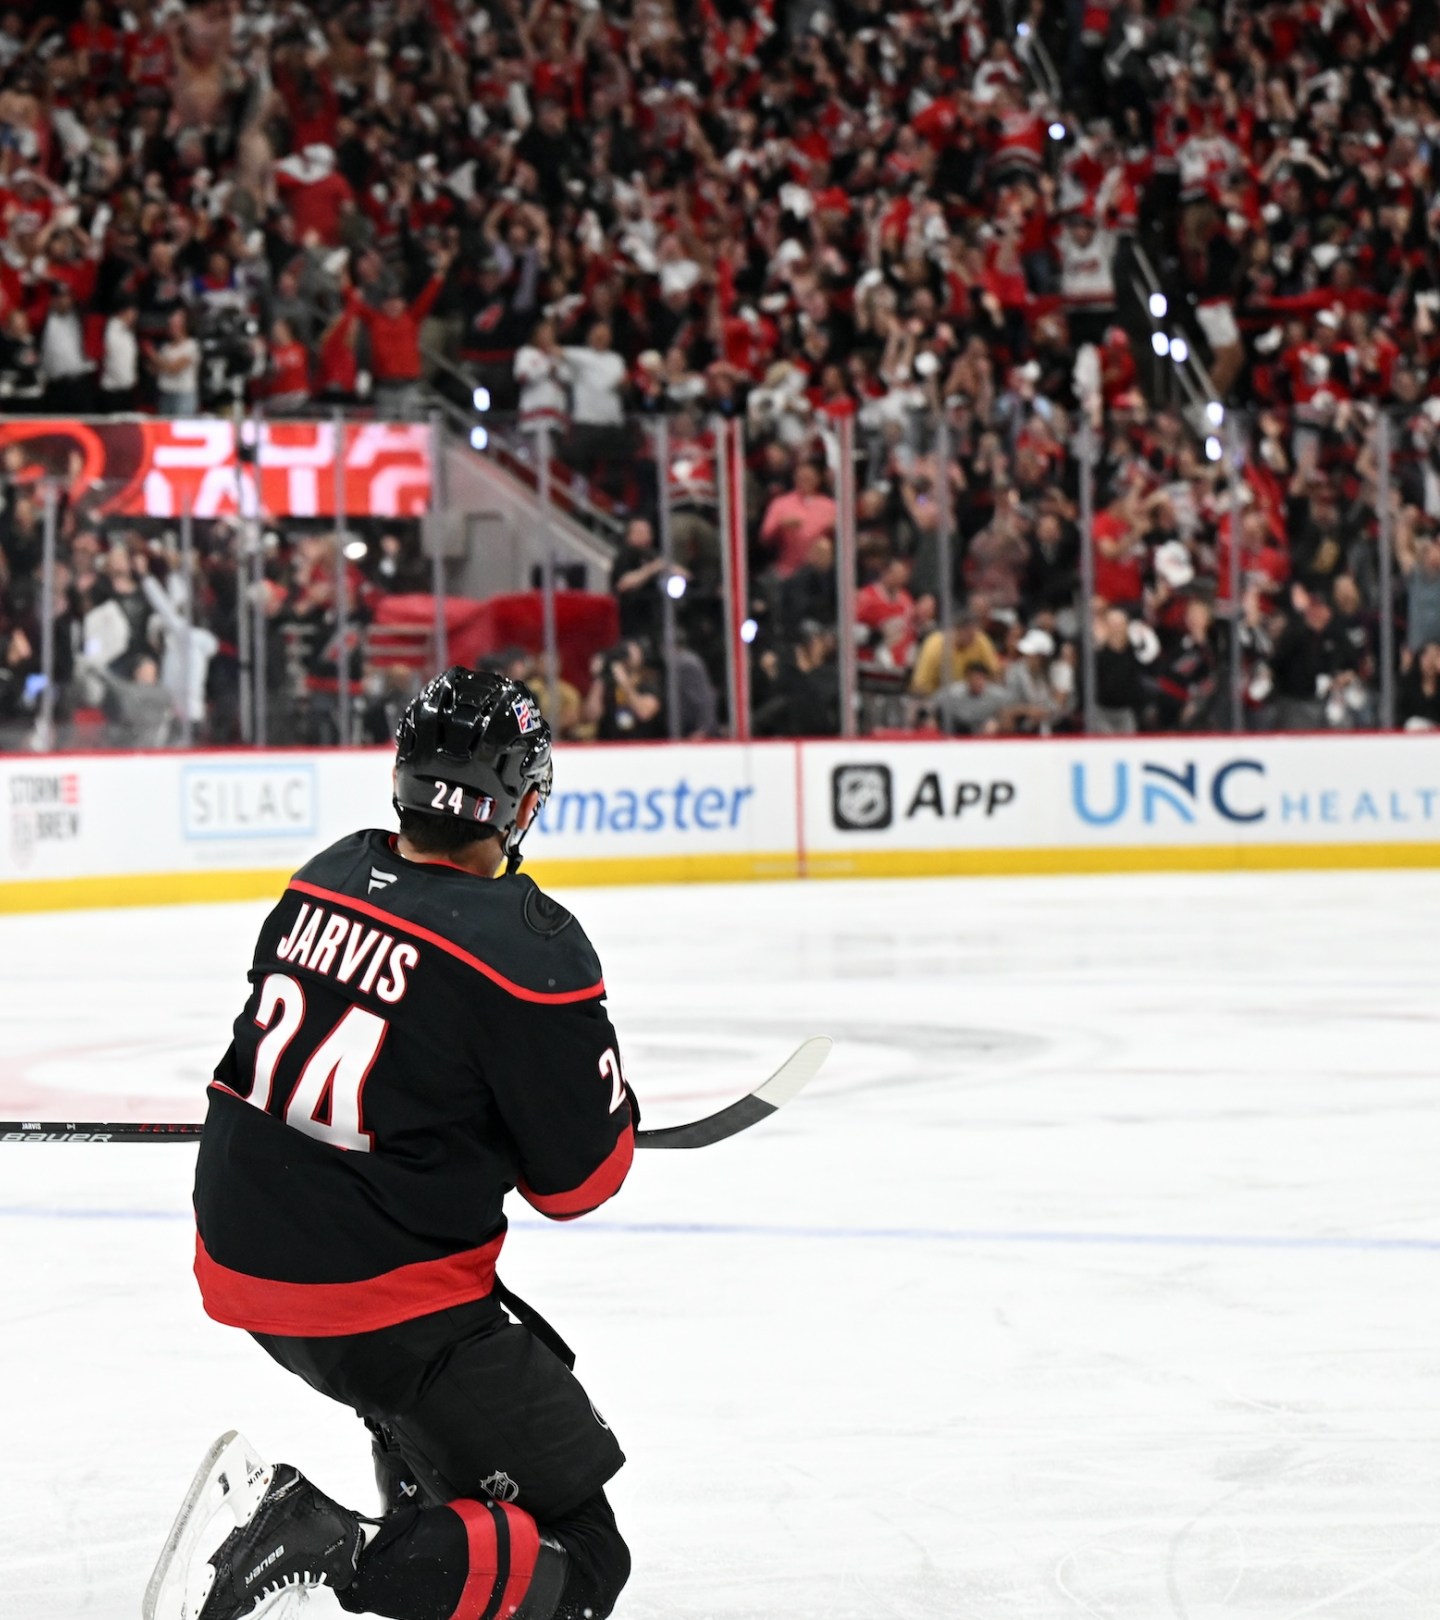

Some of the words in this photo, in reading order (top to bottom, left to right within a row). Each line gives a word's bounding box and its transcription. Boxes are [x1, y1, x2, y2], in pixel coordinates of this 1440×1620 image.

[191, 779, 307, 824] SILAC
[430, 780, 464, 815] 24
[1071, 758, 1266, 826] UNC
[276, 902, 420, 1005] JARVIS
[244, 973, 389, 1153] 24
[597, 1047, 627, 1115] 2
[21, 1122, 42, 1131] JARVIS
[245, 1545, 284, 1588] BAUER
